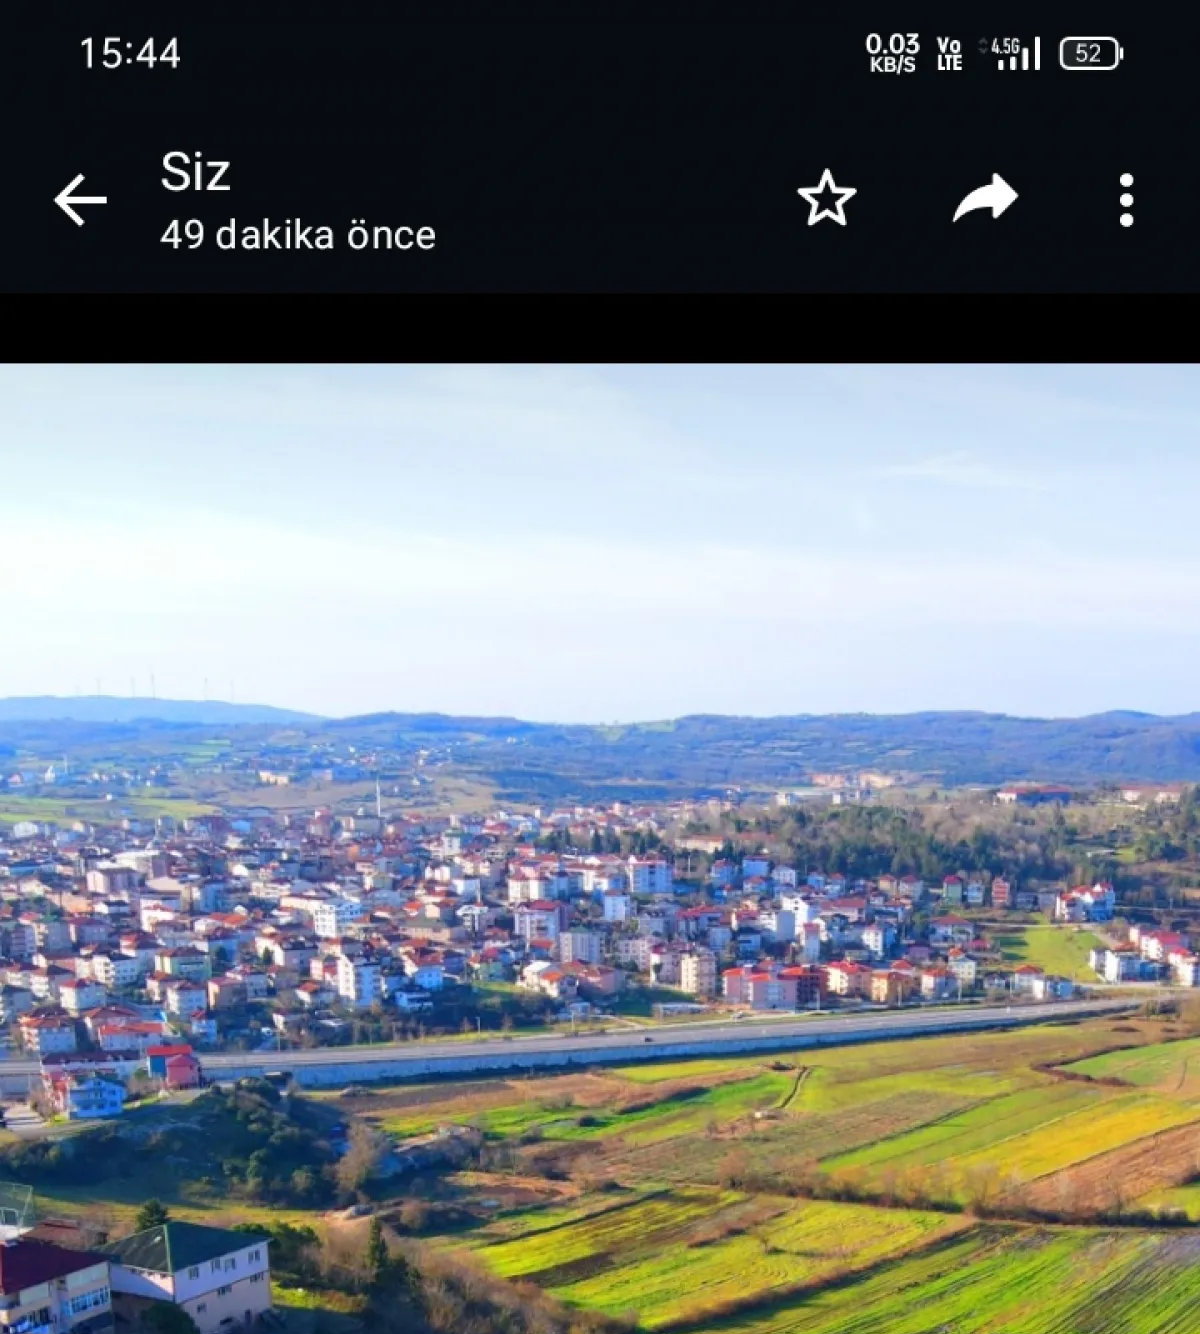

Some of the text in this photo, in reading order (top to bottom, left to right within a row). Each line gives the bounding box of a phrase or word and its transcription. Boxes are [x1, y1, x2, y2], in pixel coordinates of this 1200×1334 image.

[81, 36, 181, 69] 15:44
[865, 32, 921, 55] 0.03
[936, 36, 962, 55] Vo
[991, 37, 1021, 55] 4.5G
[1075, 42, 1101, 63] 52
[870, 55, 916, 75] KB/S
[937, 54, 963, 71] LTE
[161, 150, 231, 192] Siz
[159, 217, 437, 251] 49 dakika önce
